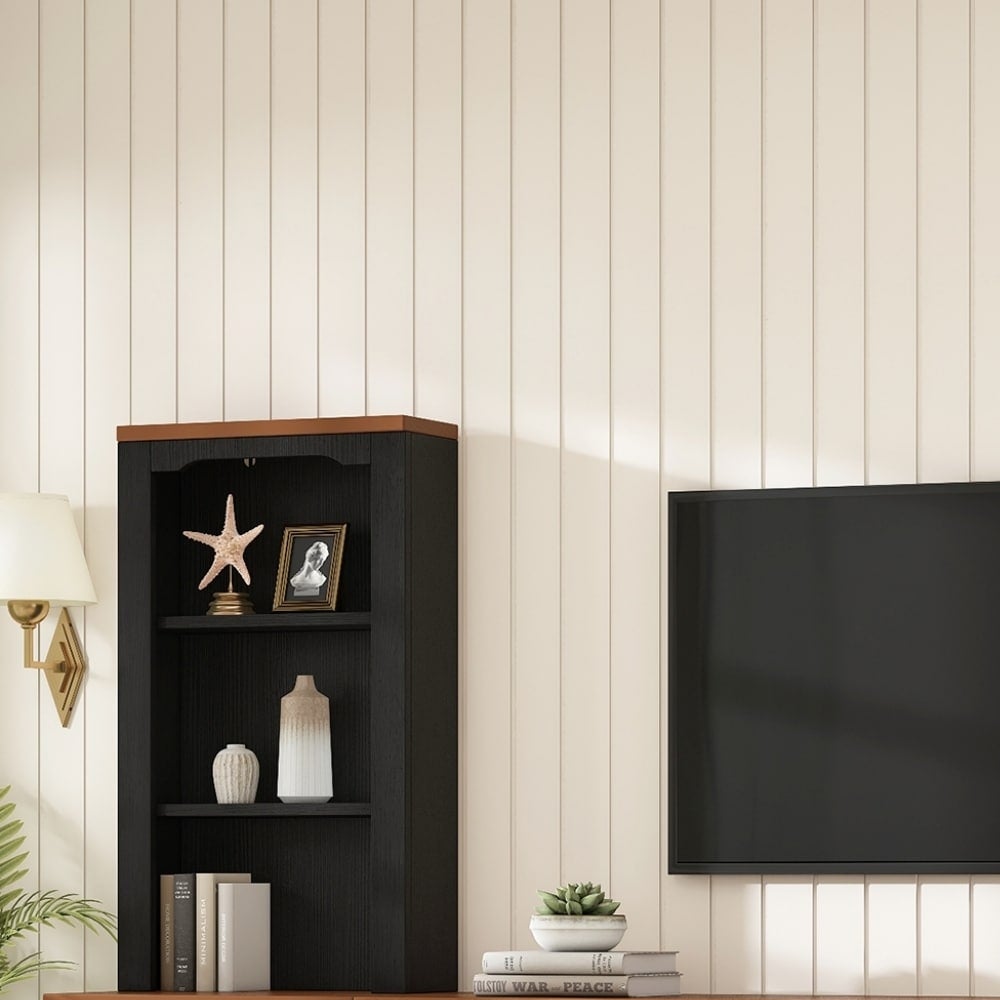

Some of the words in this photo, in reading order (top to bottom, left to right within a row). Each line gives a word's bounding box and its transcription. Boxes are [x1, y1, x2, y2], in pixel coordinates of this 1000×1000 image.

[473, 980, 507, 993] TOLSTOY
[512, 981, 550, 993] WAR
[563, 982, 614, 993] PEACE
